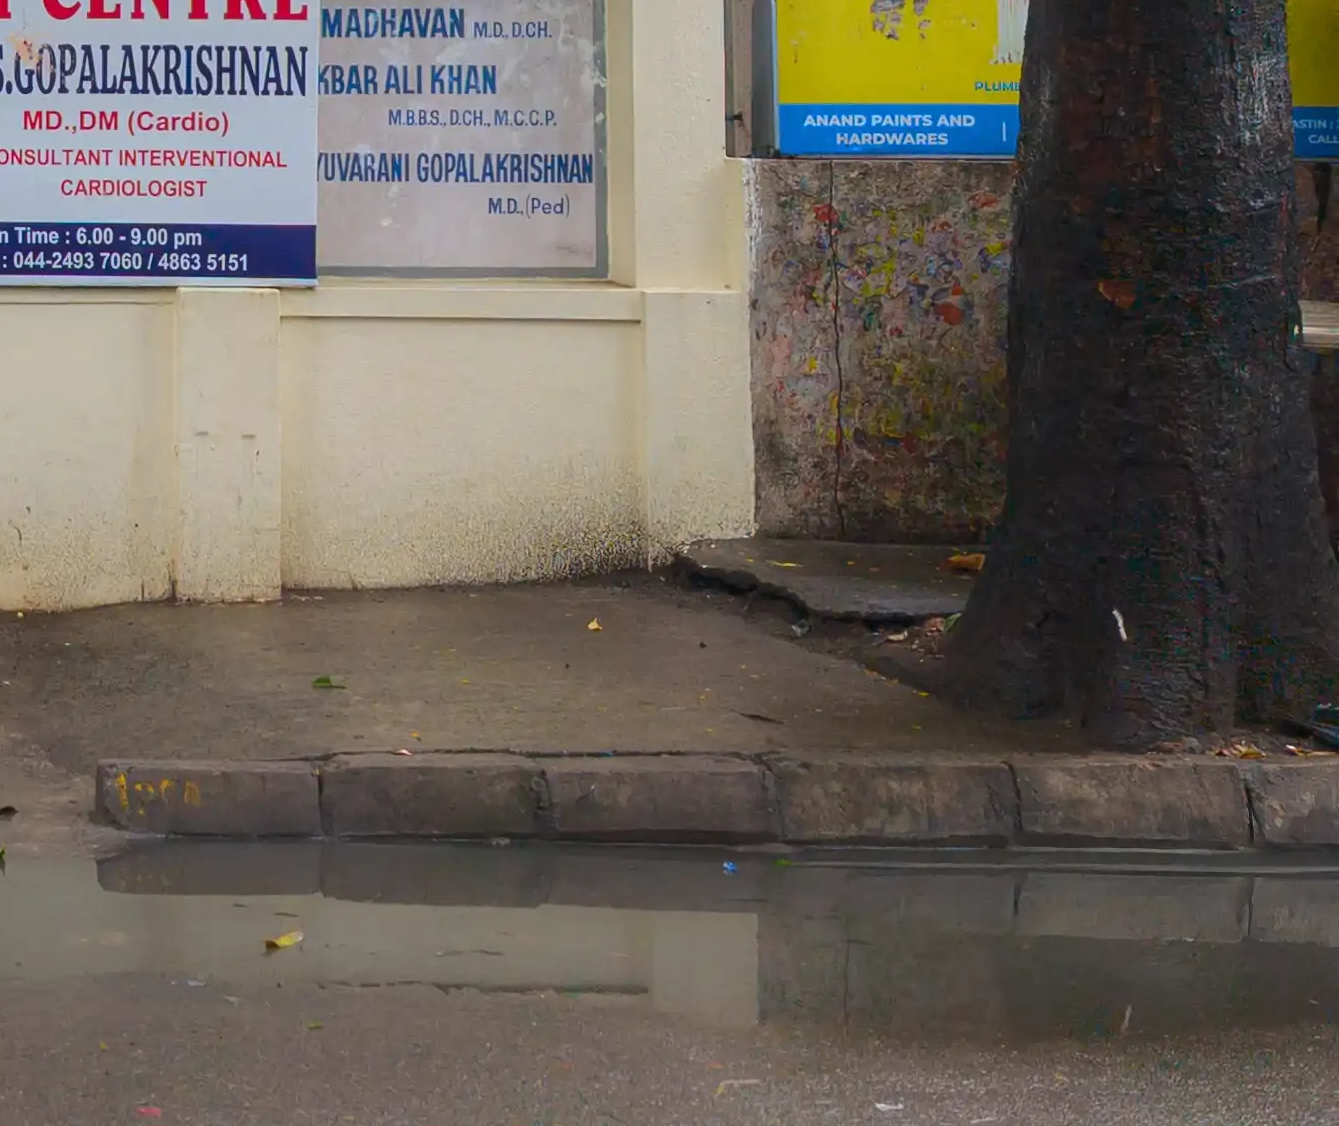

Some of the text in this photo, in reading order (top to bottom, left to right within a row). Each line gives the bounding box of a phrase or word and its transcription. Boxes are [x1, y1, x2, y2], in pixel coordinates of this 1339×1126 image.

[321, 7, 466, 39] MADHAVAN
[318, 64, 498, 95] KBAR ALI KHAN
[127, 110, 230, 136] (Cardio)
[803, 114, 976, 127] ANAND PAINTS AND
[835, 132, 949, 146] HARDWARES
[118, 149, 288, 168] INTERVENTIONAL
[416, 153, 594, 184] GOPALAKRISHNAN
[60, 178, 208, 198] CARDIOLOGIST
[525, 193, 571, 219] (Ped)
[14, 226, 60, 245] Time
[76, 228, 114, 245] 6.00
[130, 228, 169, 246] 9.00
[173, 232, 203, 249] pm
[13, 252, 95, 271] 044-2493
[99, 253, 143, 271] 7060
[157, 253, 204, 272] 4863
[207, 254, 249, 272] 5151
